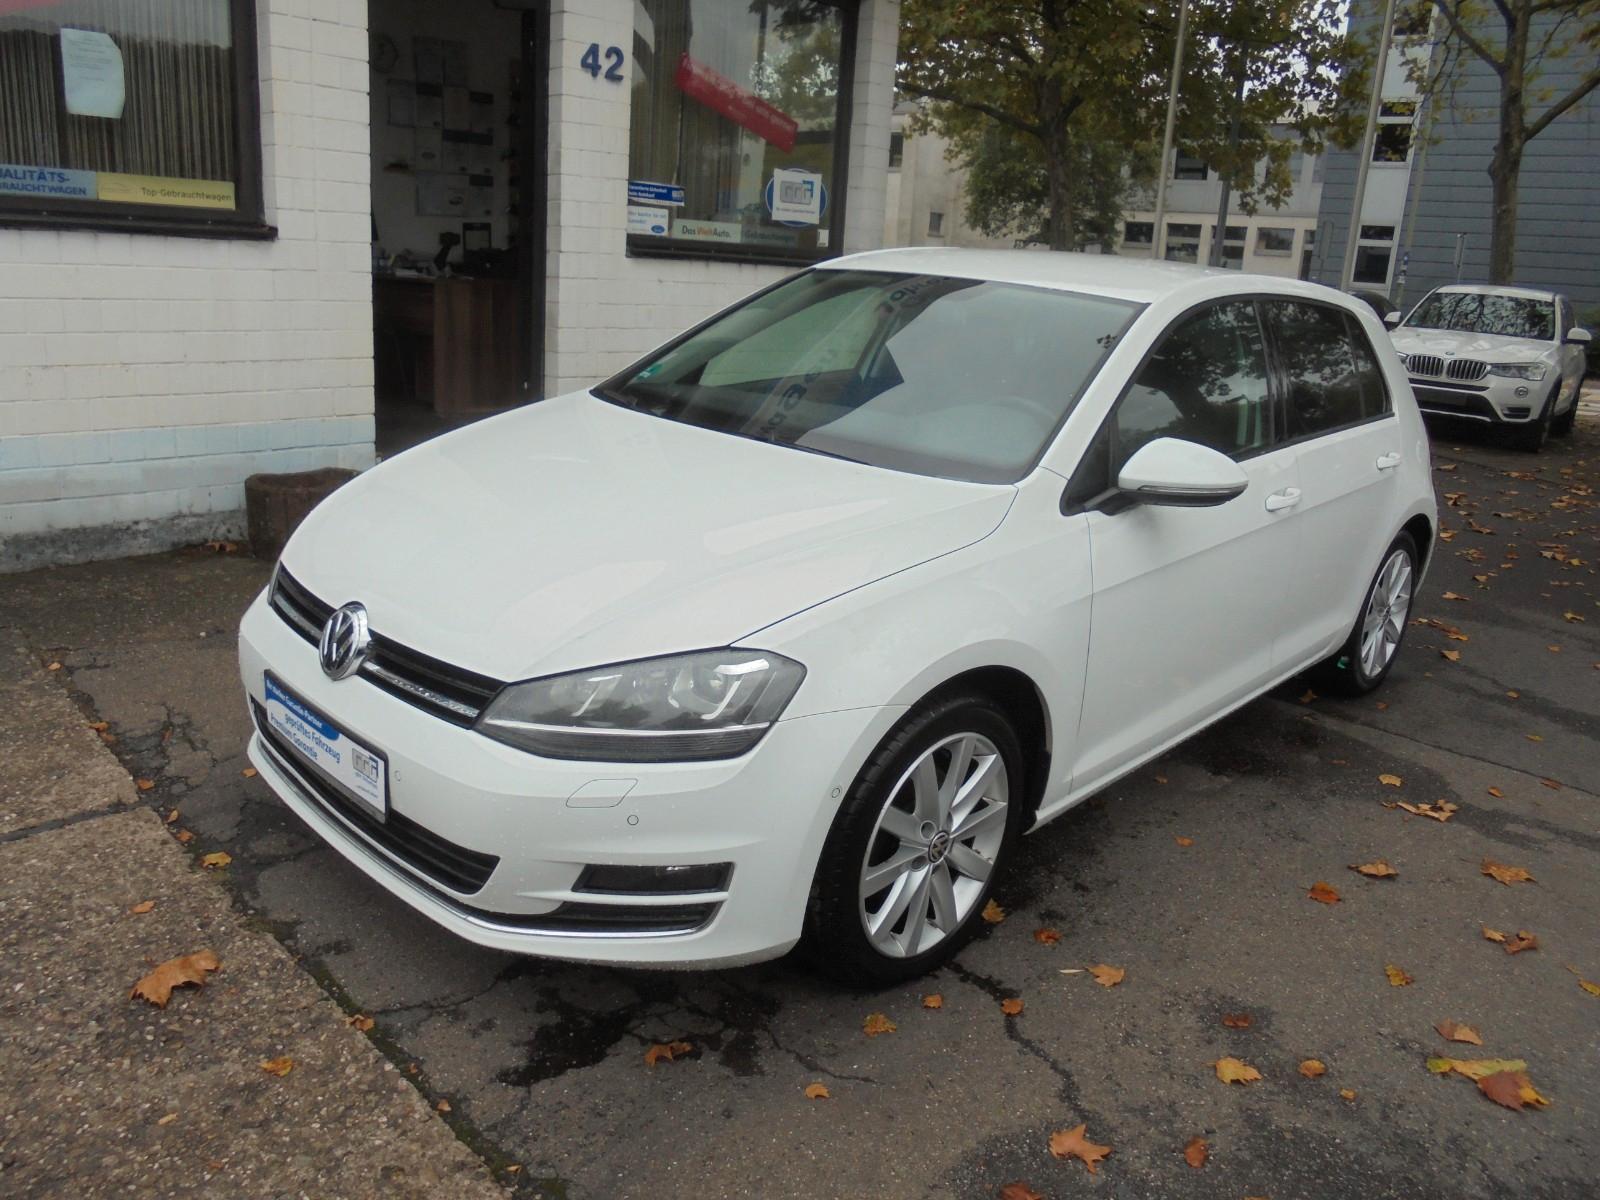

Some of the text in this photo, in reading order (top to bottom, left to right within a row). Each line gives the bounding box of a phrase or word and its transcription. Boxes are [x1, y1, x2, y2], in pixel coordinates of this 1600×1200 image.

[580, 42, 625, 82] 42
[0, 168, 70, 183] ALITÄTS-
[0, 181, 87, 196] RAUCHTWAGEN
[681, 224, 696, 236] Das
[312, 730, 341, 764] Fahrzeug
